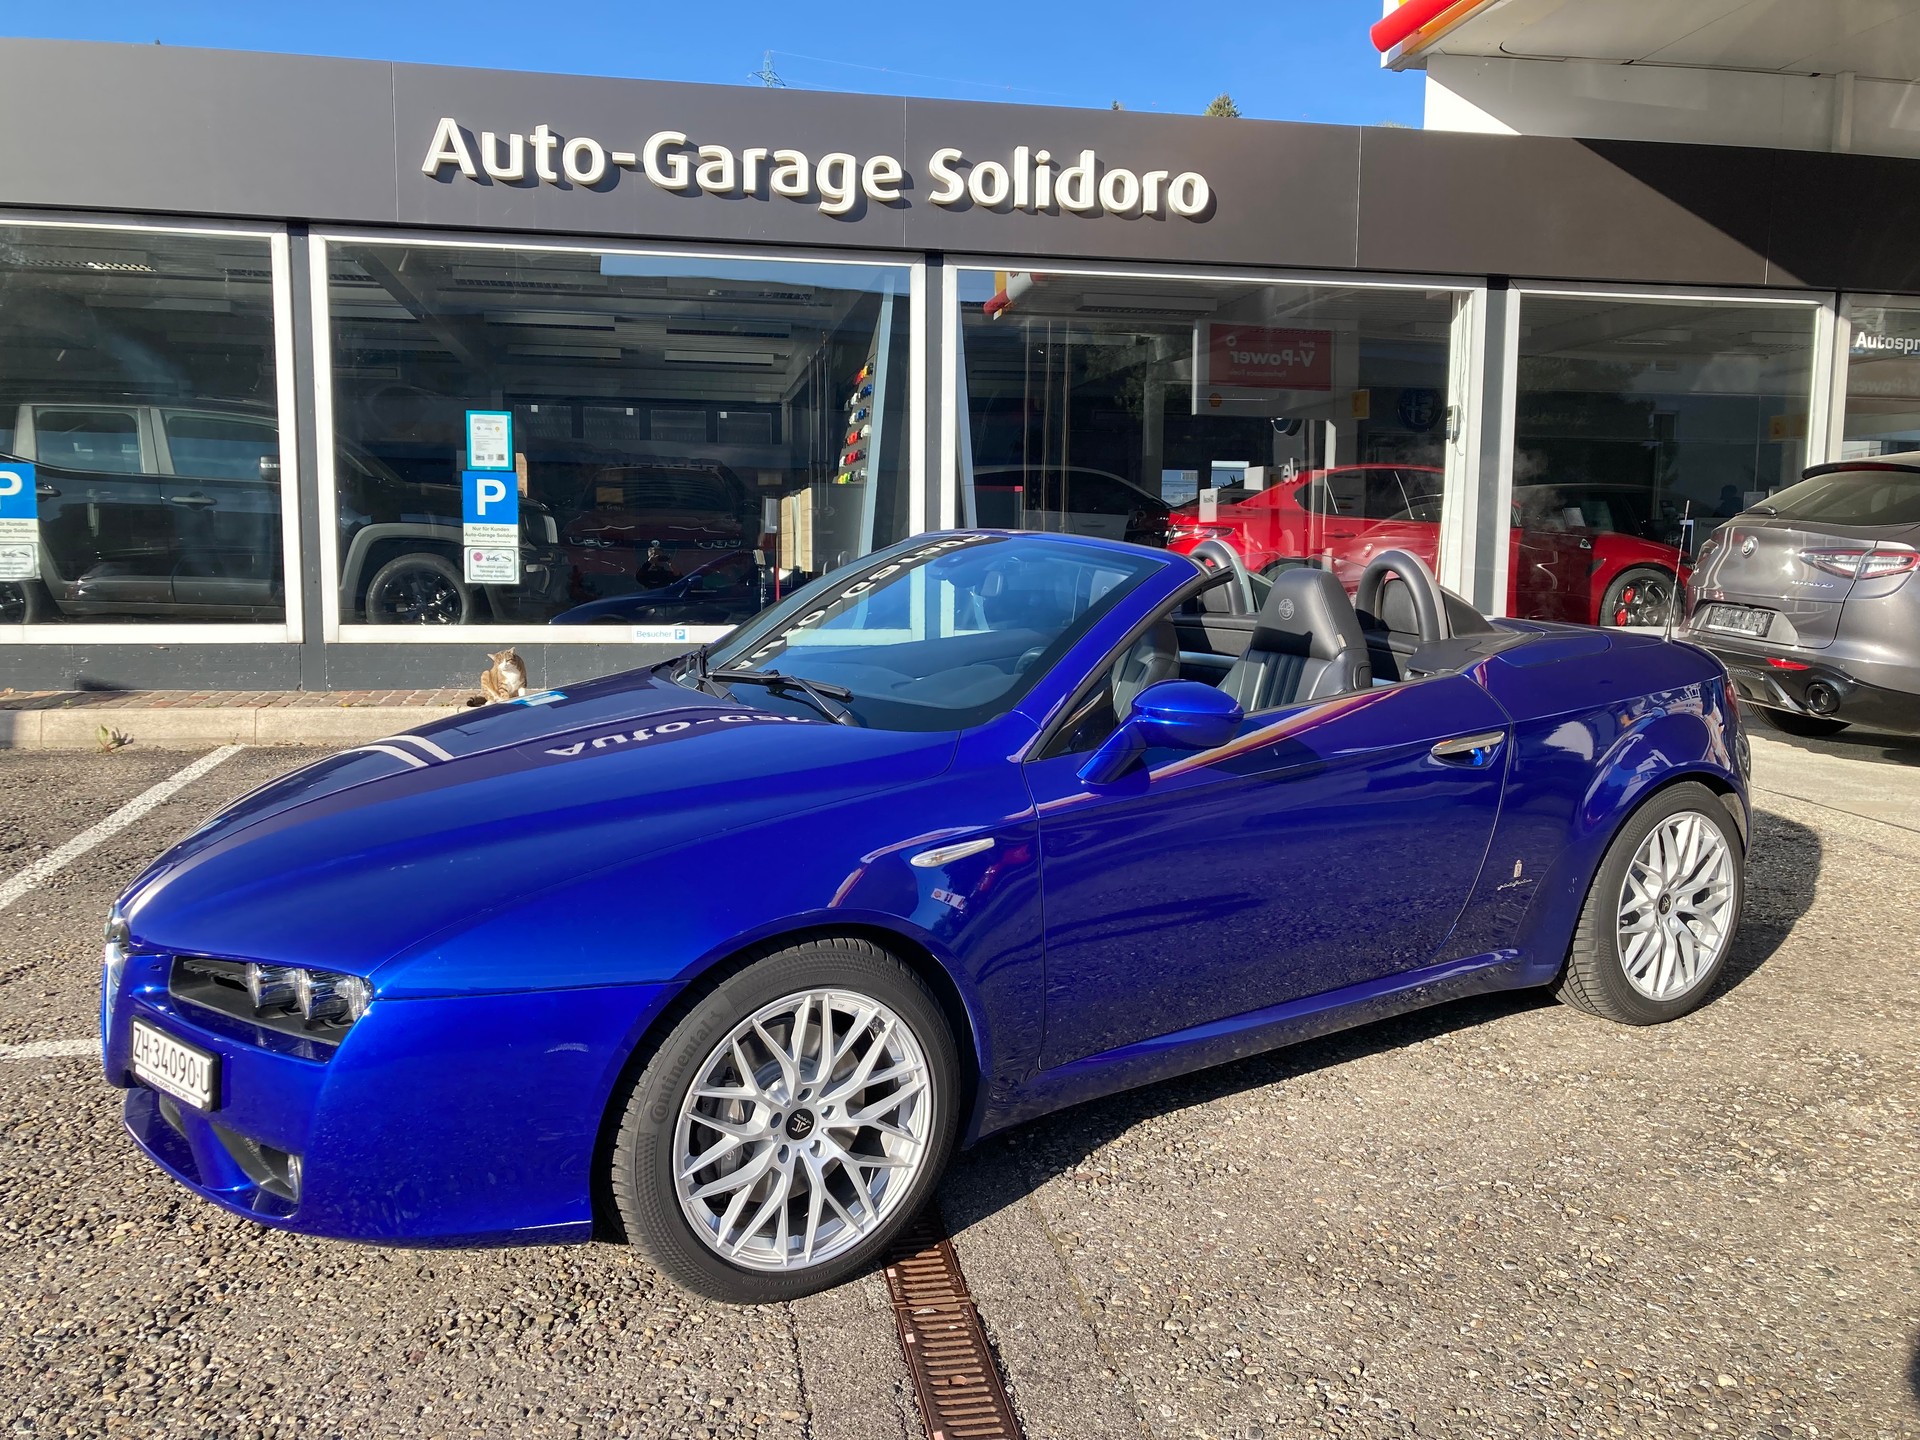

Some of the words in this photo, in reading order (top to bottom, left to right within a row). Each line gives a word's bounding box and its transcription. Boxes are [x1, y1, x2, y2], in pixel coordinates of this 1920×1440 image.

[421, 117, 904, 214] Auto-Garage
[927, 145, 1210, 216] Solidoro
[477, 478, 507, 516] P
[636, 630, 672, 638] Besucher
[650, 1019, 714, 1125] Continental
